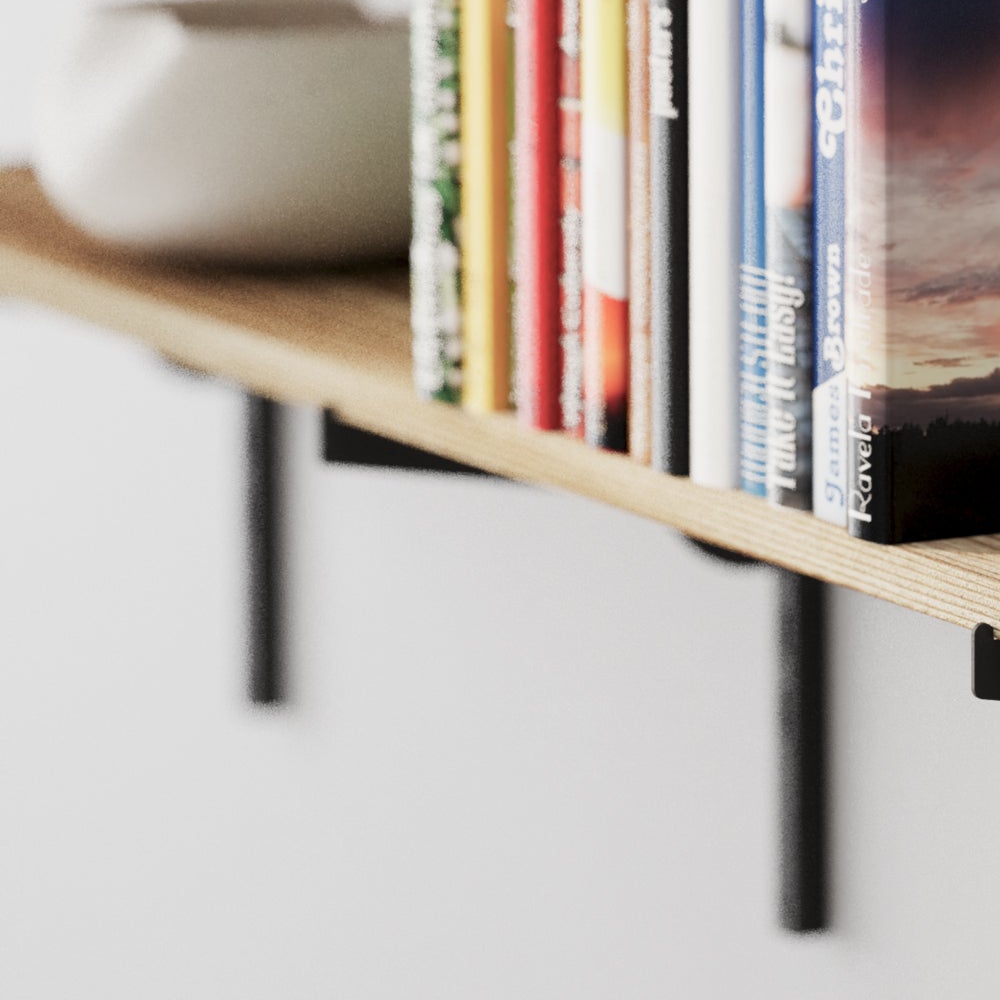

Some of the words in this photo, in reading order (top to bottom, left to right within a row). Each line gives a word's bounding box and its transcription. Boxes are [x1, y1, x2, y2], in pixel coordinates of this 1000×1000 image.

[823, 243, 846, 372] Brown
[764, 407, 797, 490] Take
[824, 384, 845, 507] James
[848, 413, 873, 523] Ravela
